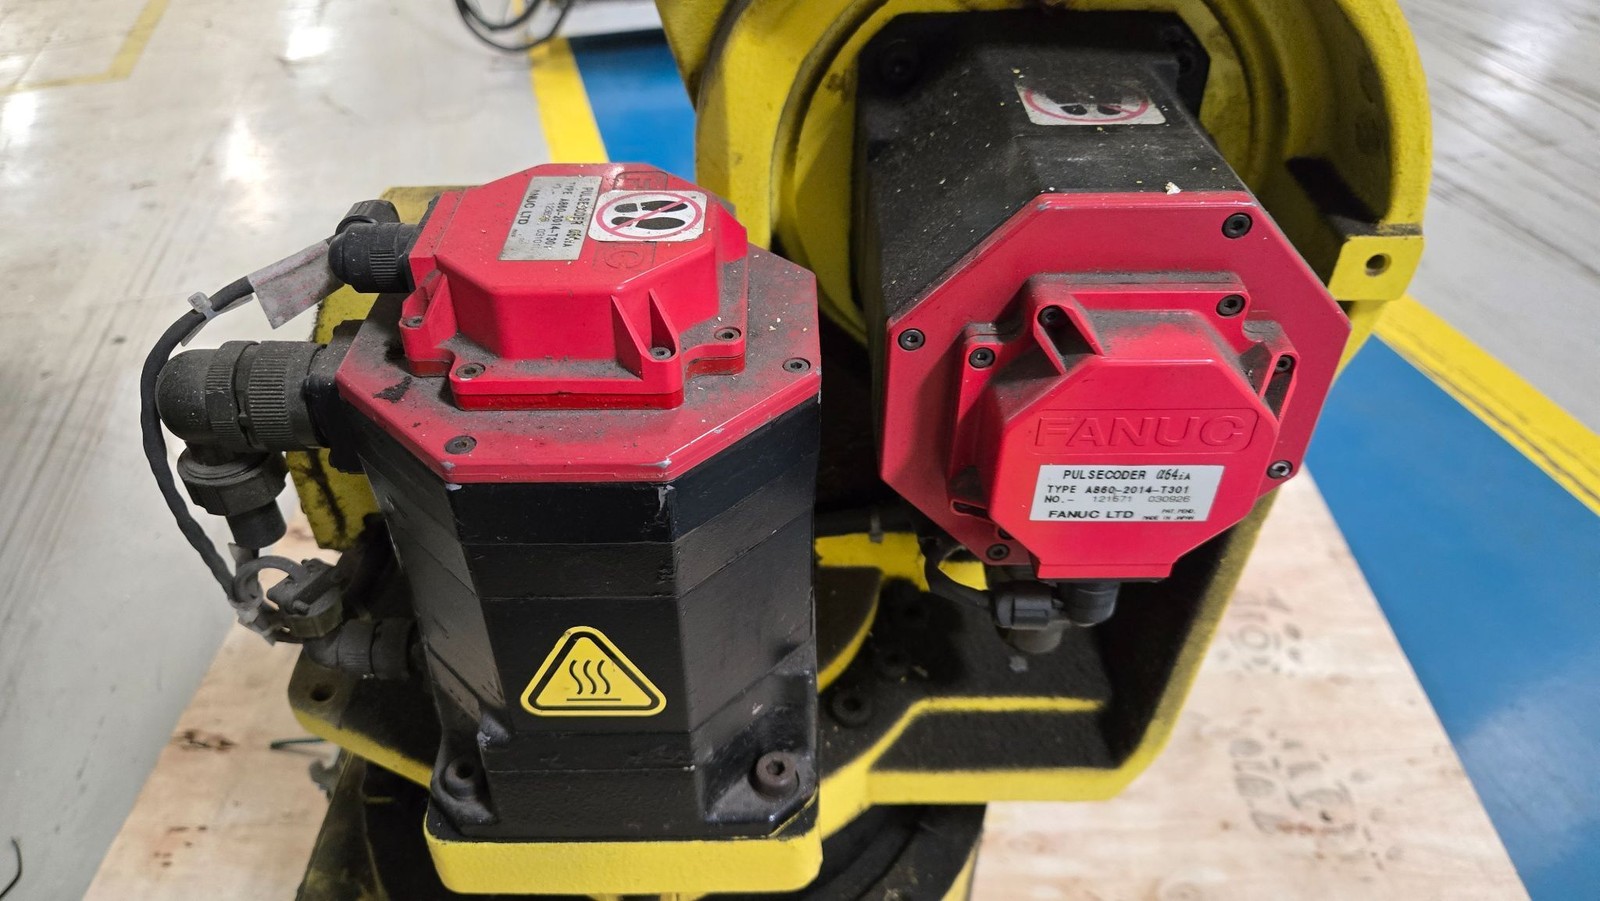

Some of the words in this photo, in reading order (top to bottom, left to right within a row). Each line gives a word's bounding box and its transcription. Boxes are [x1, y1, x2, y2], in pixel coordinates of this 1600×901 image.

[517, 210, 532, 224] LTD
[1034, 415, 1246, 447] FANUC
[1063, 470, 1146, 480] PULSECODER
[1047, 484, 1077, 494] TYPE
[1084, 485, 1190, 494] A860-2014-T301
[1147, 495, 1191, 503] 030926
[1048, 510, 1101, 519] FANUC
[1106, 510, 1135, 519] LTD
